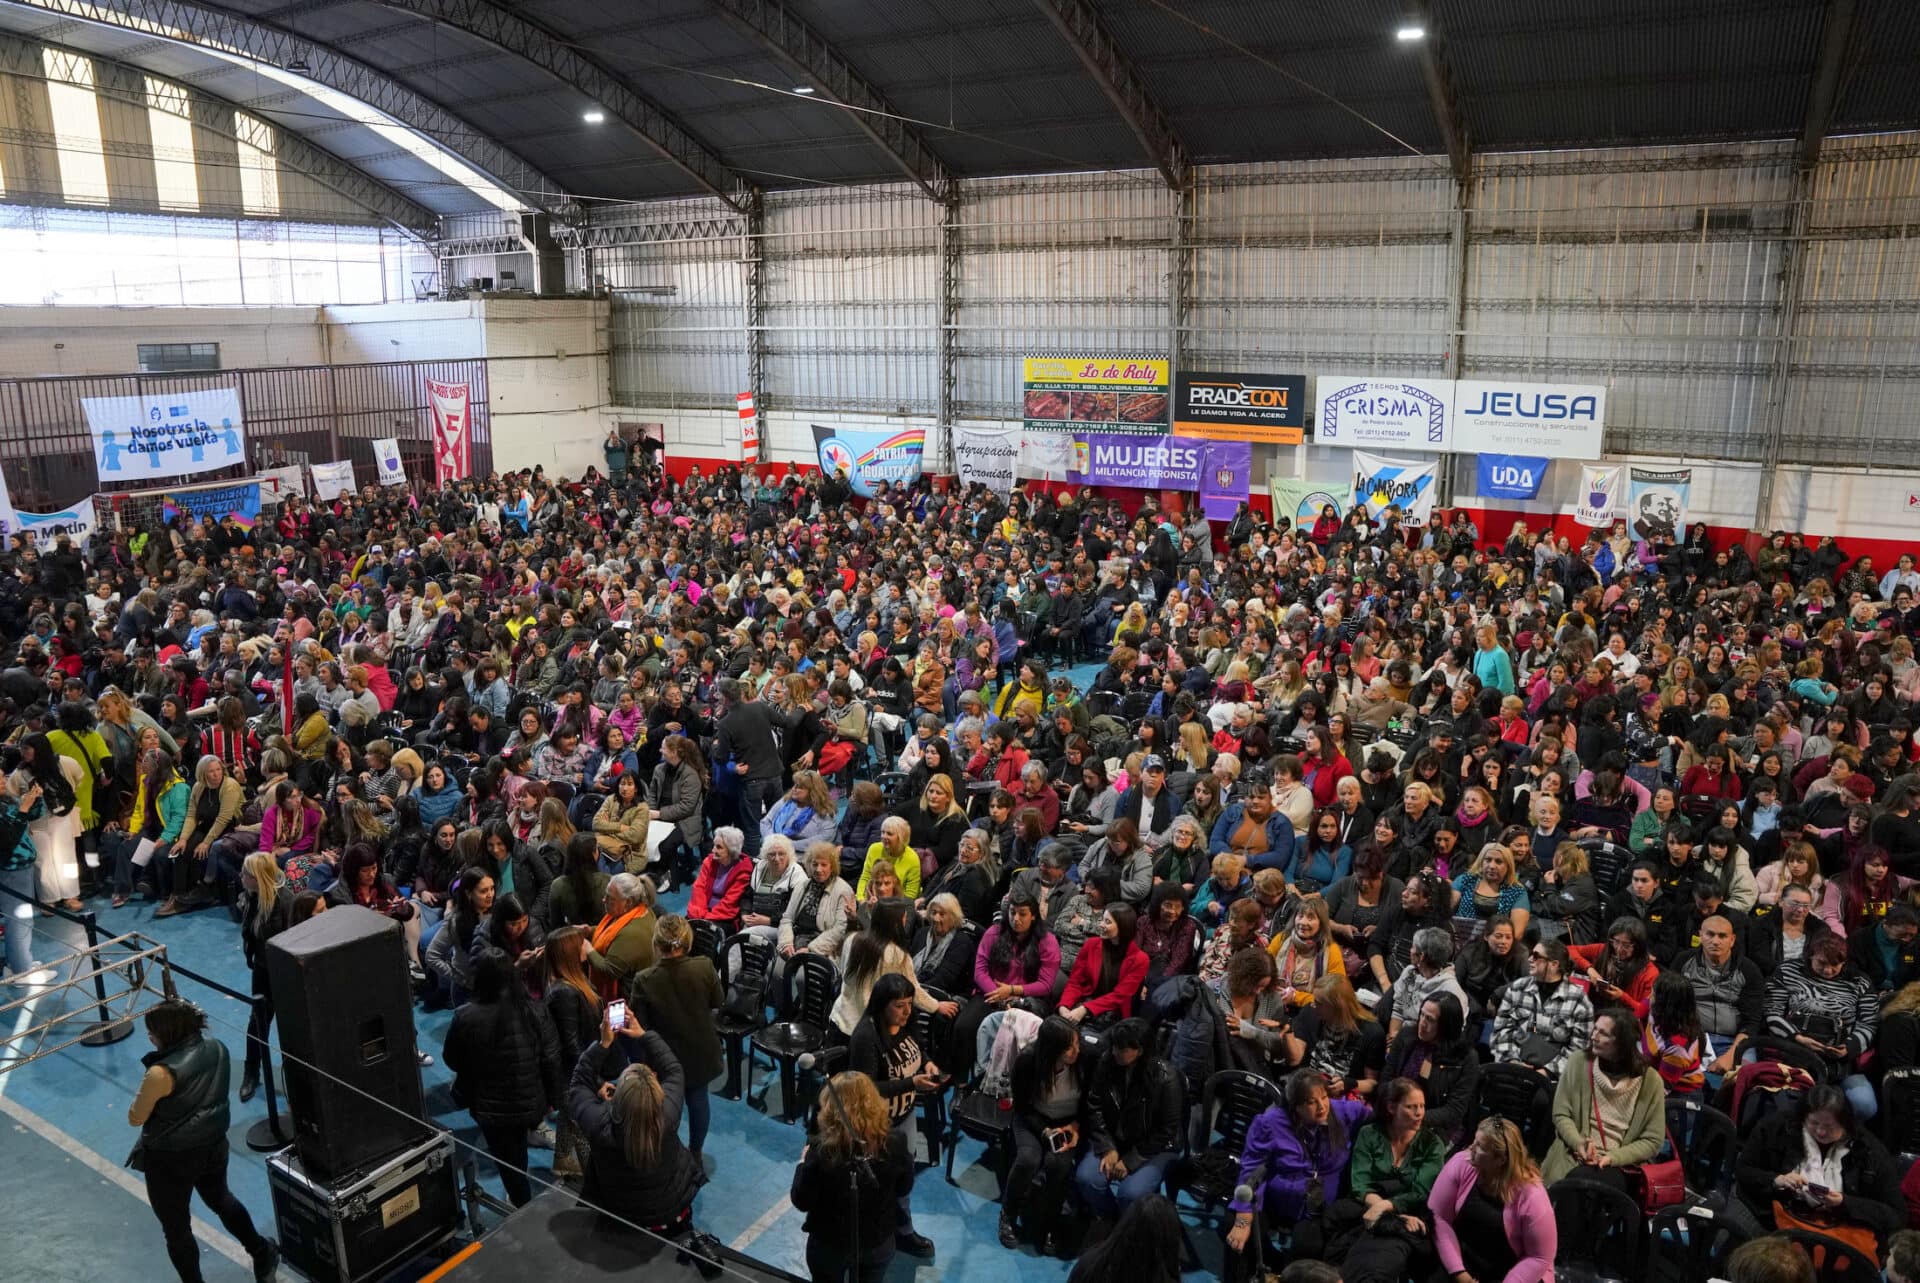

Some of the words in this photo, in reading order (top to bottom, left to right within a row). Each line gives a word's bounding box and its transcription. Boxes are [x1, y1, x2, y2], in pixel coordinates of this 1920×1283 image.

[1079, 363, 1098, 378] Lo
[1102, 364, 1119, 378] de
[1123, 364, 1157, 384] Roly
[1190, 387, 1288, 407] PRADECON
[1370, 383, 1399, 391] TECHOS
[1345, 397, 1422, 417] CRISMA
[1464, 391, 1597, 421] JEUSA
[130, 422, 193, 439] Nosotrxs
[195, 418, 208, 431] la
[127, 438, 173, 454] damos
[176, 432, 218, 449] vuelta
[873, 447, 907, 460] PATRIA
[1095, 445, 1198, 470] MUJERES
[962, 463, 1013, 480] Peronista
[1095, 467, 1147, 478] MILITANCIA
[1149, 469, 1198, 481] PERONISTA
[1355, 472, 1366, 491] LA
[1492, 466, 1533, 487] UDA
